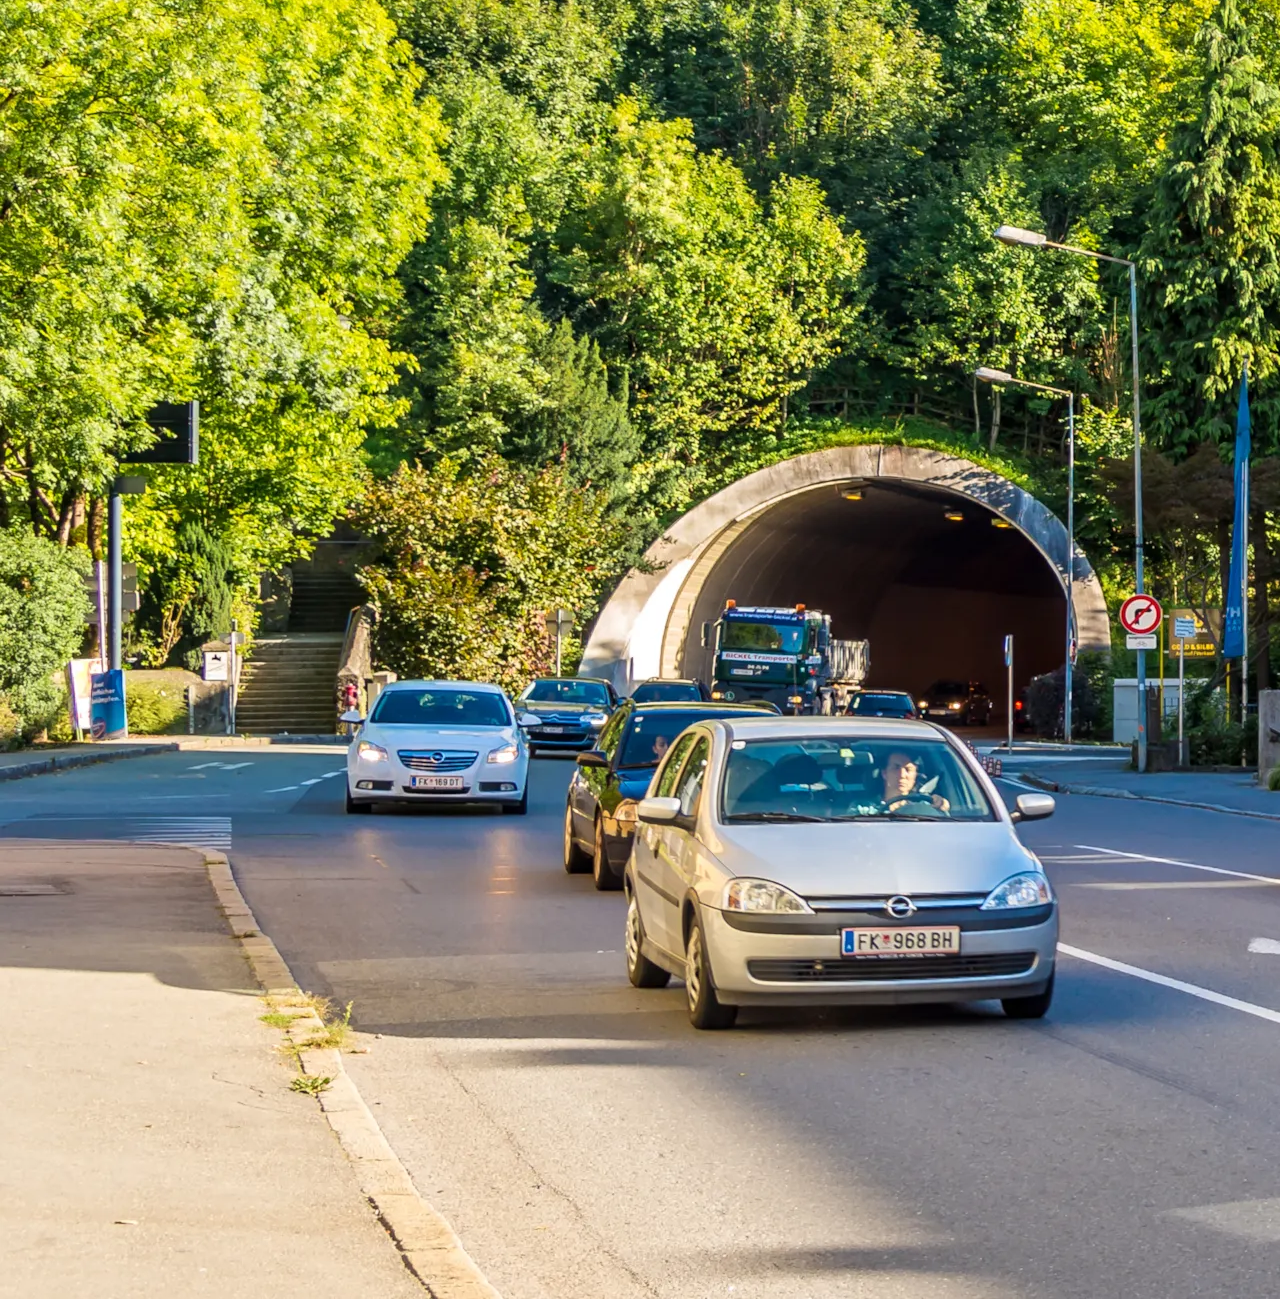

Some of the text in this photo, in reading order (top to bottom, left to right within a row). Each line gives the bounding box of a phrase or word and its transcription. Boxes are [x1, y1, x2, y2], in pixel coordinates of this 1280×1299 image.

[858, 931, 953, 950] FK 968 BH
